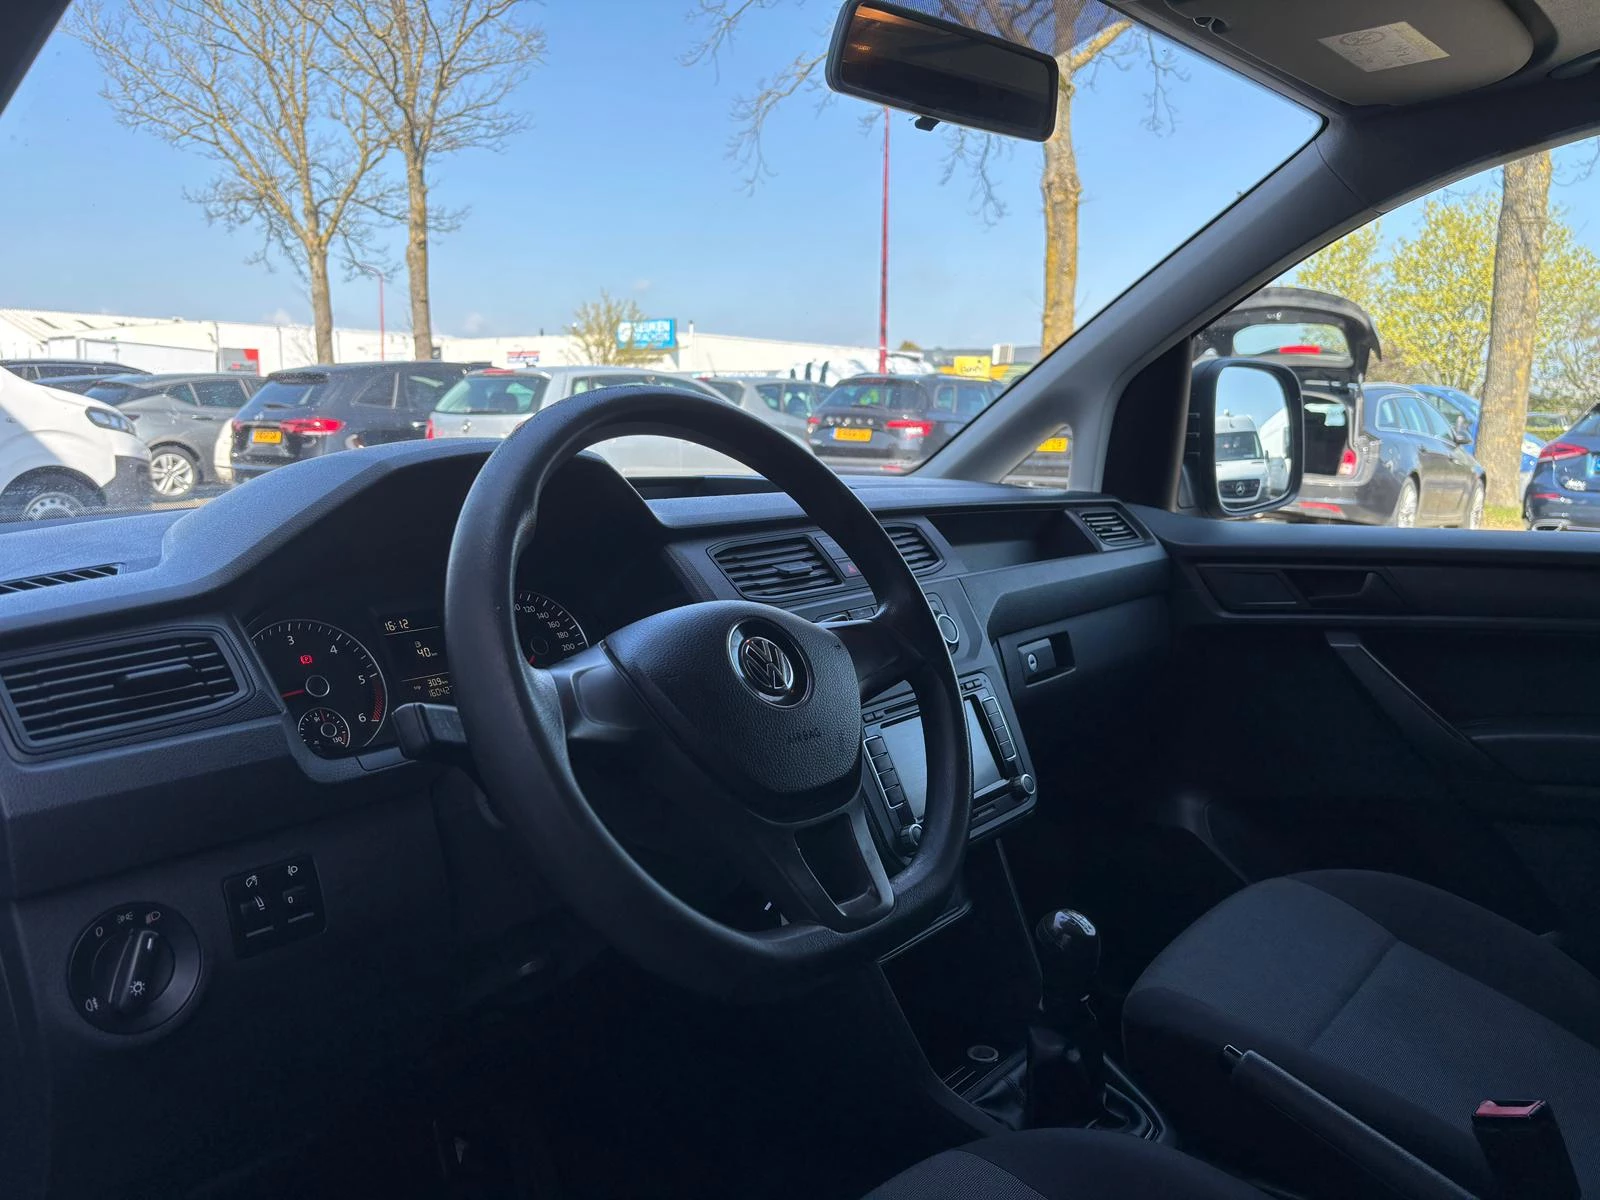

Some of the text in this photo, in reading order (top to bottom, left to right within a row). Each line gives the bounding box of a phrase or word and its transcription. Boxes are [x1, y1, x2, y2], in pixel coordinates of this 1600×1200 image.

[523, 605, 536, 613] 120
[536, 611, 550, 620] 140
[384, 618, 410, 632] 16:12
[547, 621, 560, 629] 160
[287, 635, 295, 646] 3
[556, 631, 569, 639] 180
[329, 644, 338, 655] 4
[416, 647, 432, 658] 40
[561, 643, 576, 652] 200
[358, 674, 366, 685] 5
[358, 712, 367, 723] 6
